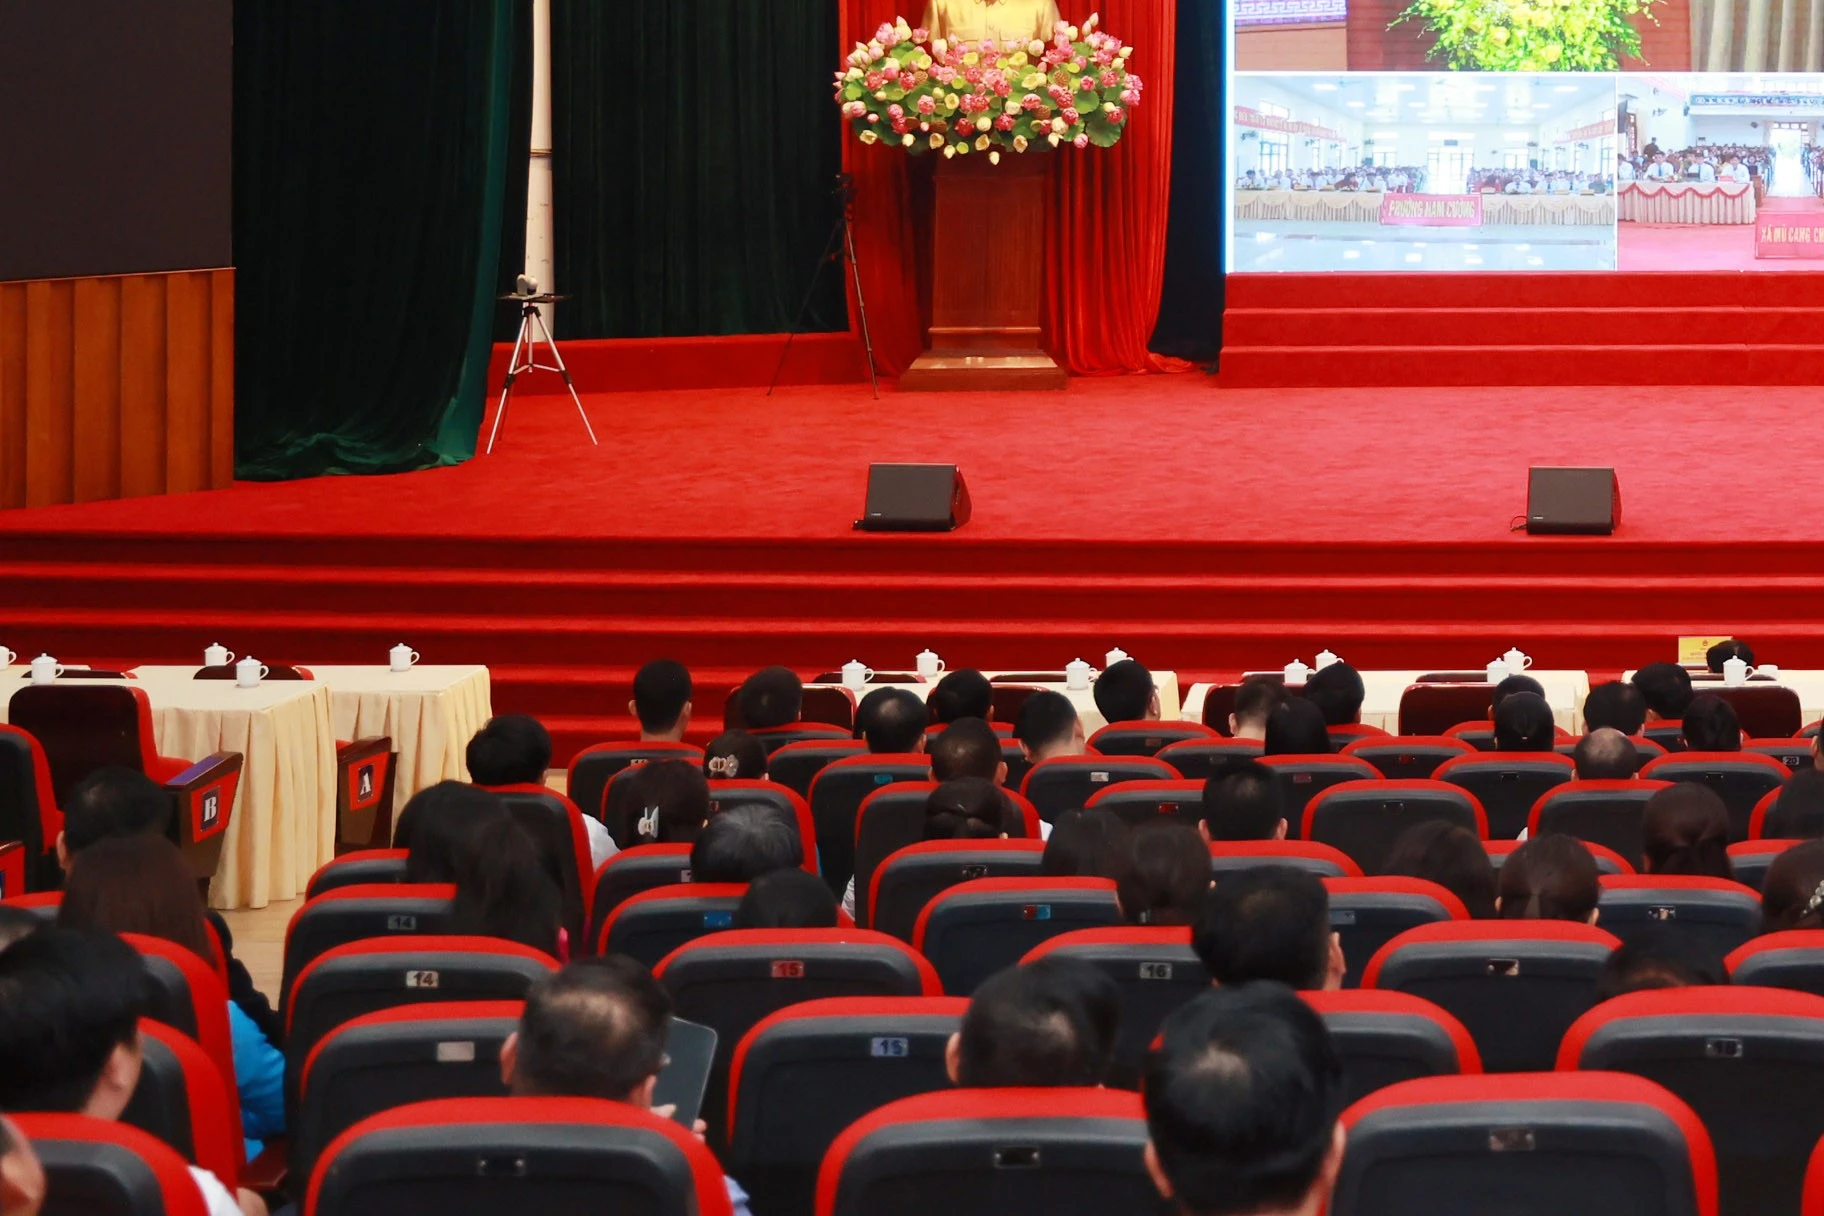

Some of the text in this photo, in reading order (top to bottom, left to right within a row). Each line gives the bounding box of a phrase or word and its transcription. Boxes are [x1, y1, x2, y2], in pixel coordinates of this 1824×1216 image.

[360, 772, 371, 795] A
[204, 796, 217, 822] B
[779, 963, 799, 976] 15
[1146, 965, 1167, 977] 16
[413, 972, 434, 986] 14
